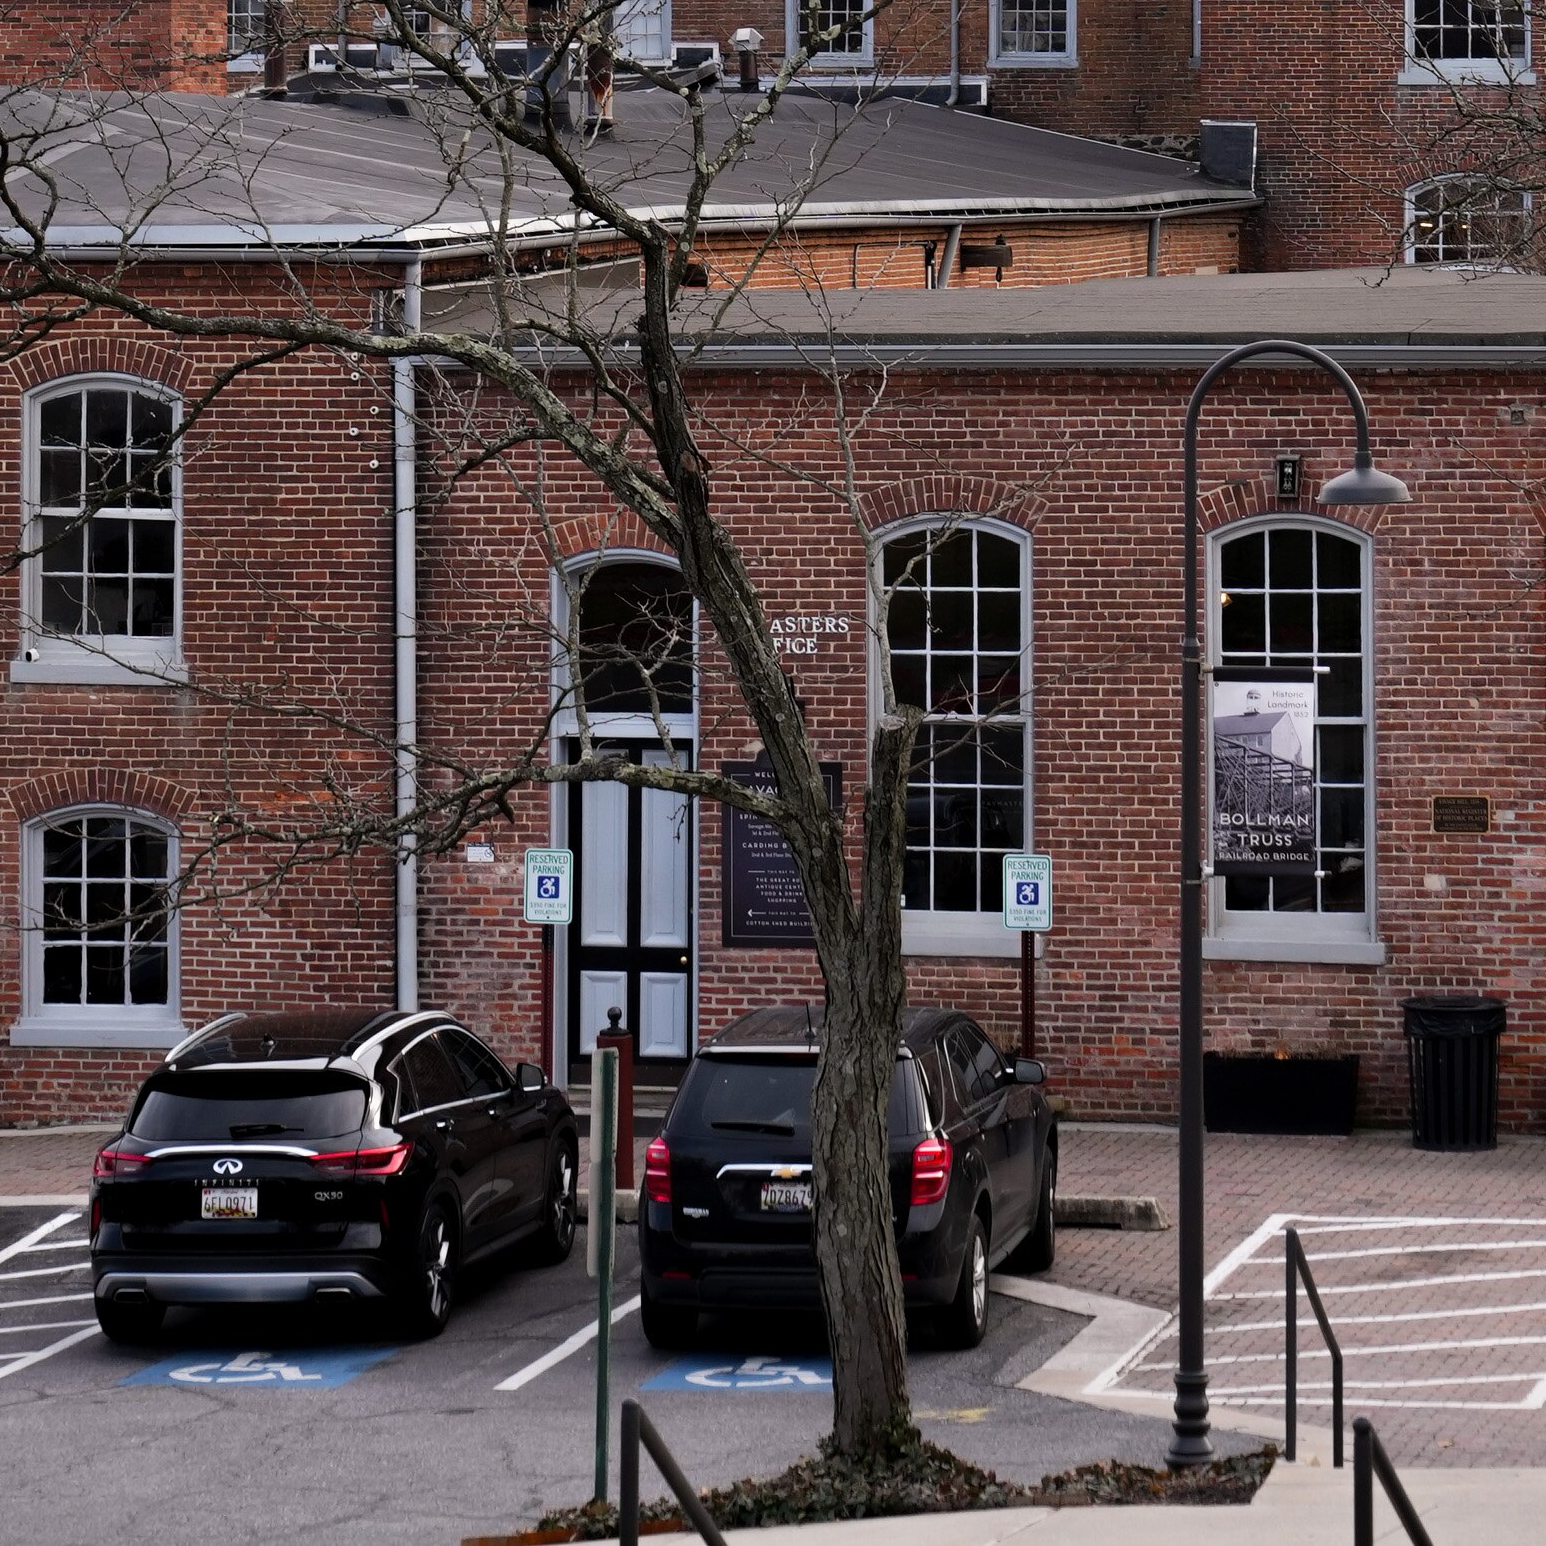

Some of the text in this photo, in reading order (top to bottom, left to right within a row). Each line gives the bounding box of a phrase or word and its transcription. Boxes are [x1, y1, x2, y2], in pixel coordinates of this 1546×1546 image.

[770, 616, 849, 634] ASTERS
[772, 637, 818, 654] FICE
[1272, 690, 1304, 698] Historic
[1267, 700, 1309, 709] Landmark
[1220, 813, 1309, 826] BOLLMAN
[1237, 834, 1293, 846] TRUSS
[529, 854, 569, 864] RESERVED
[1218, 852, 1309, 861] RAILROAD BRIDGE
[532, 865, 565, 874] PARKING
[1008, 860, 1048, 870] RESERVED
[1011, 871, 1044, 881] PARKING
